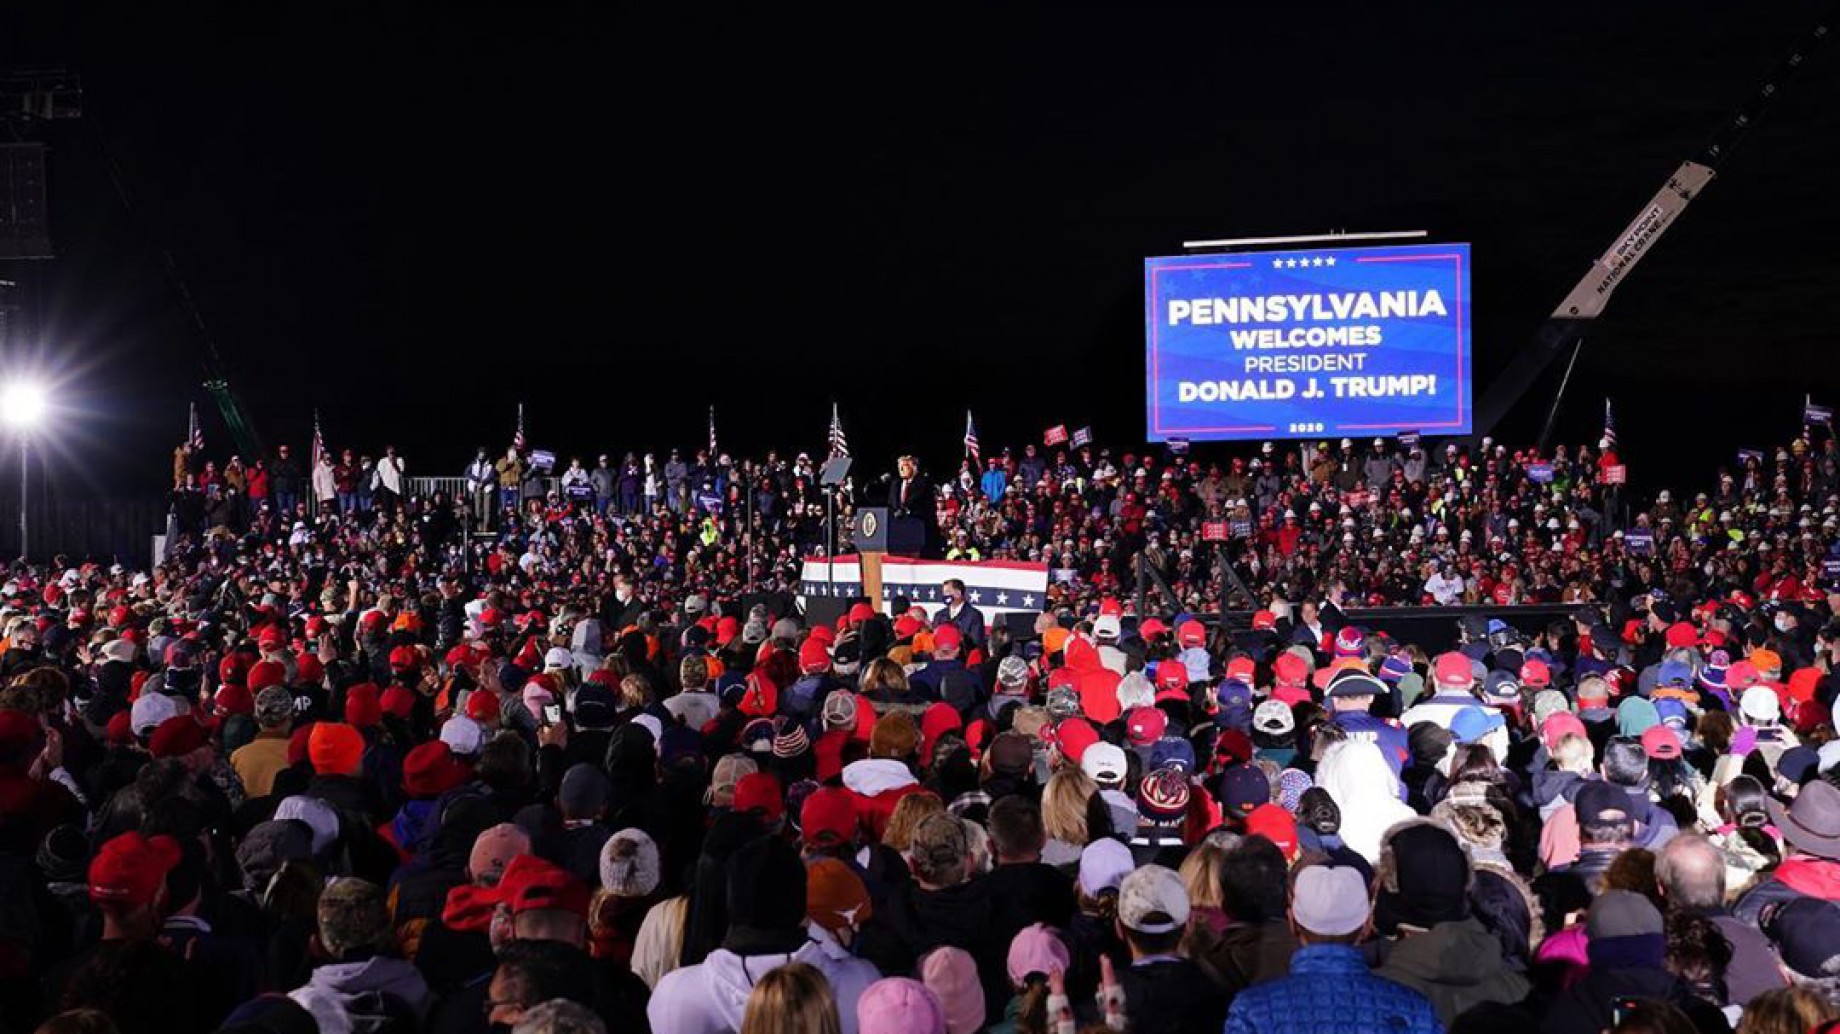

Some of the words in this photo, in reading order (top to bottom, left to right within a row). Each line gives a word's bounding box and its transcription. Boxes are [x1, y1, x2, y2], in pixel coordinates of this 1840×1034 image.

[1597, 251, 1636, 294] NATIONAL
[1634, 219, 1662, 251] CRANE
[1168, 289, 1448, 326] PENNSYLVANIA
[1230, 325, 1383, 350] WELCOMES
[1244, 353, 1367, 373] PRESIDENT
[1178, 380, 1296, 403] DONALD
[1301, 378, 1325, 400] J.
[1330, 375, 1437, 398] TRUMP!
[1289, 422, 1325, 433] 2020
